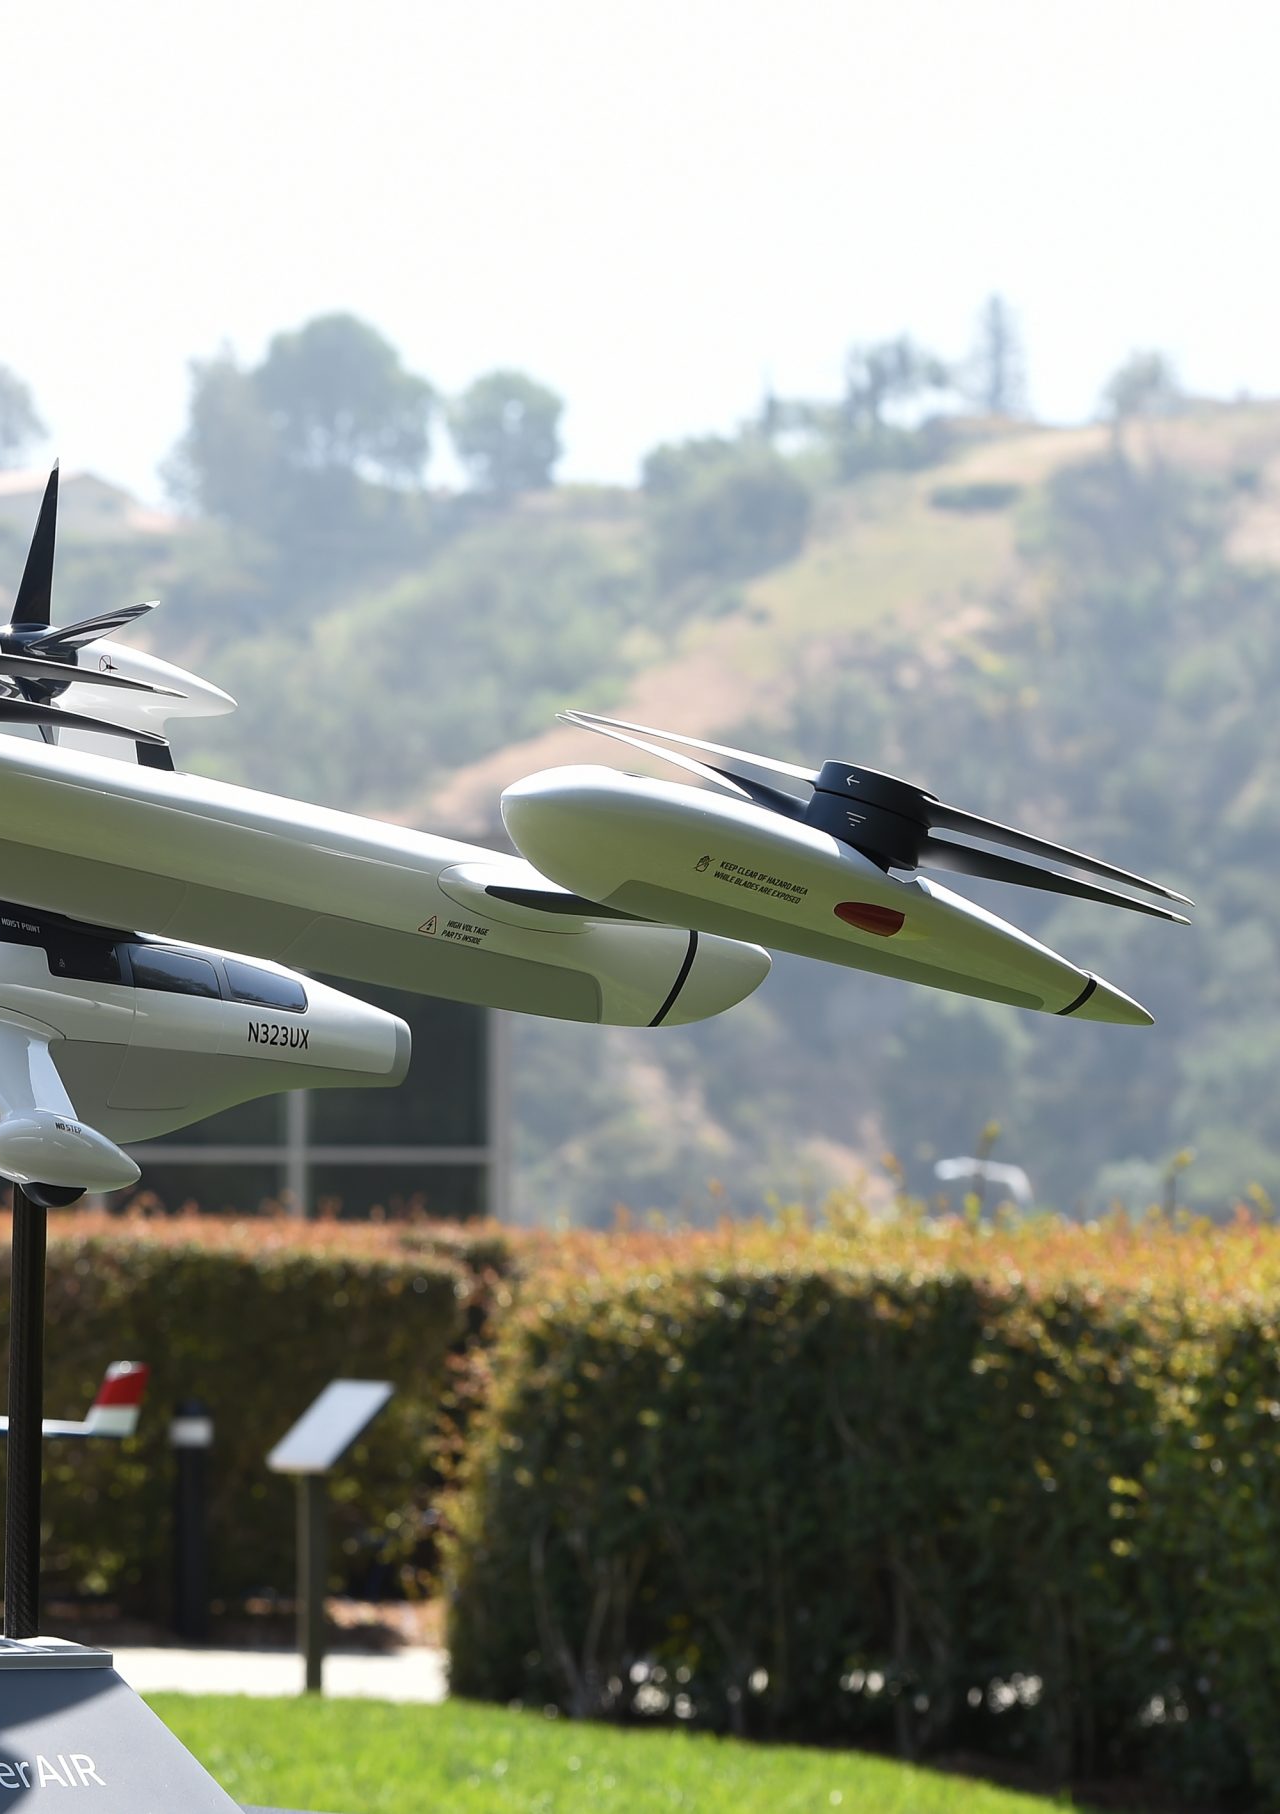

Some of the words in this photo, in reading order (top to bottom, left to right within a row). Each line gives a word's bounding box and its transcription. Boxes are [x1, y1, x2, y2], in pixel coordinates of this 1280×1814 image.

[720, 861, 739, 872] KEEP
[737, 866, 758, 880] CLEAR
[757, 873, 768, 882] OF
[766, 876, 792, 890] HAZARD
[790, 884, 808, 896] AREA
[713, 870, 736, 883] WHILE
[734, 877, 760, 891] BLADES
[758, 885, 773, 895] ARE
[770, 890, 802, 905] EXPOSED
[21, 922, 40, 934] POINT
[446, 920, 463, 930] HIGH
[461, 922, 490, 936] VOLTAGE
[440, 929, 462, 940] PARTS
[461, 934, 483, 945] INSIDE
[248, 1021, 310, 1050] N323UX
[55, 1122, 66, 1131] NO
[65, 1124, 82, 1134] STEP
